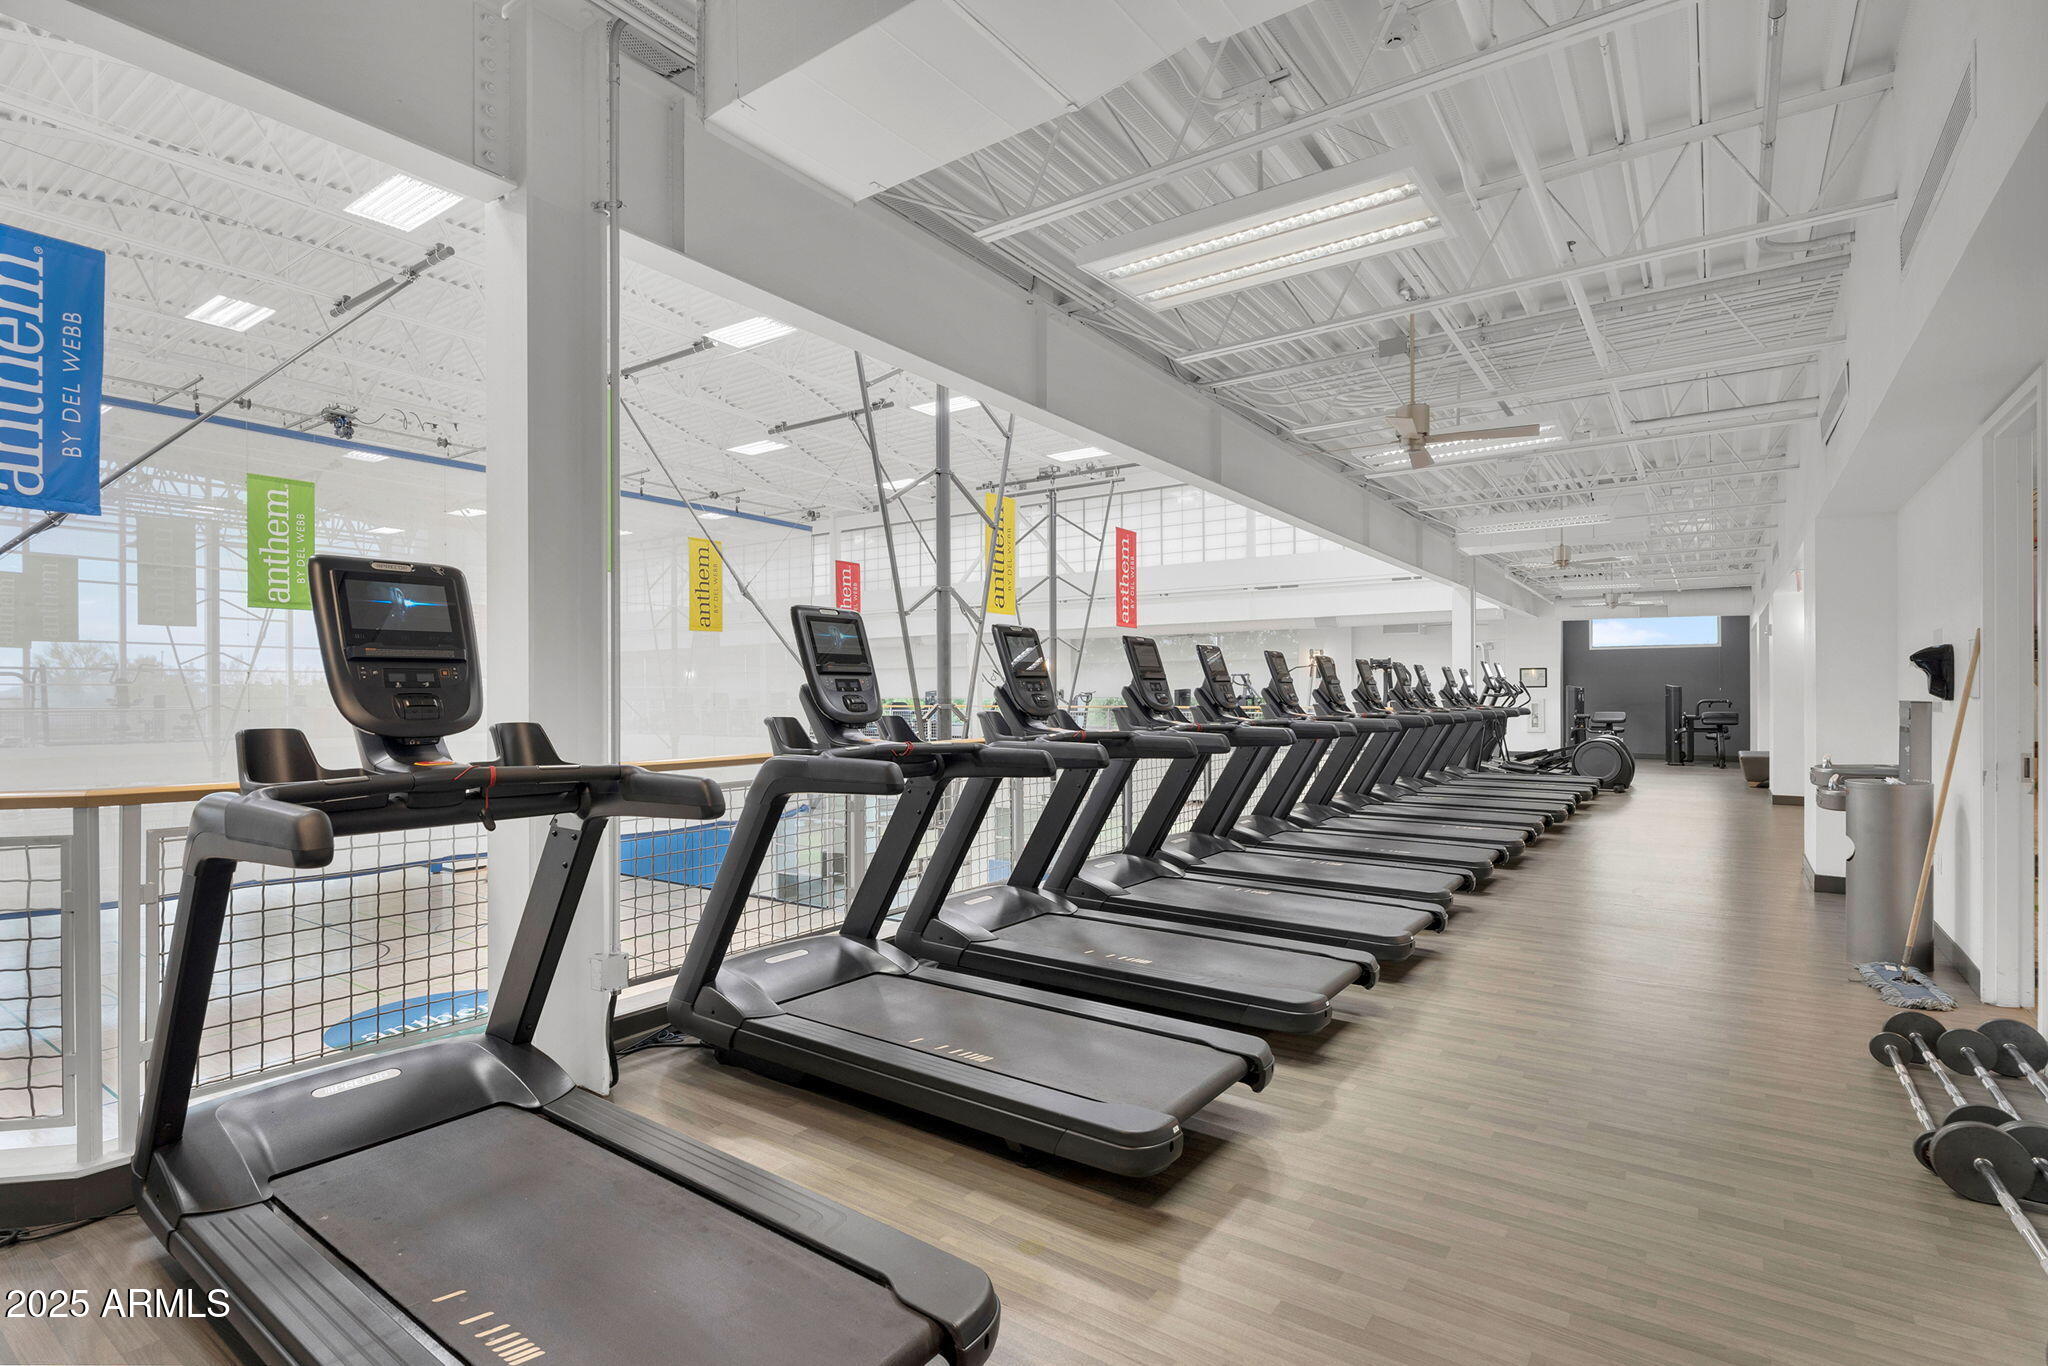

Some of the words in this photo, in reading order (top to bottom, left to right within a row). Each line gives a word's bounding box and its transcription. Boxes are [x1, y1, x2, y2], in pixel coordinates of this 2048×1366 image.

[62, 312, 82, 371] WEBB
[62, 383, 81, 423] DEL
[62, 431, 82, 458] BY
[259, 488, 290, 604] anthem
[296, 513, 306, 543] WEBB
[296, 548, 306, 567] DEL
[296, 571, 306, 584] BY
[695, 547, 711, 628] anthem
[840, 569, 851, 609] hem
[1120, 538, 1130, 623] anthem
